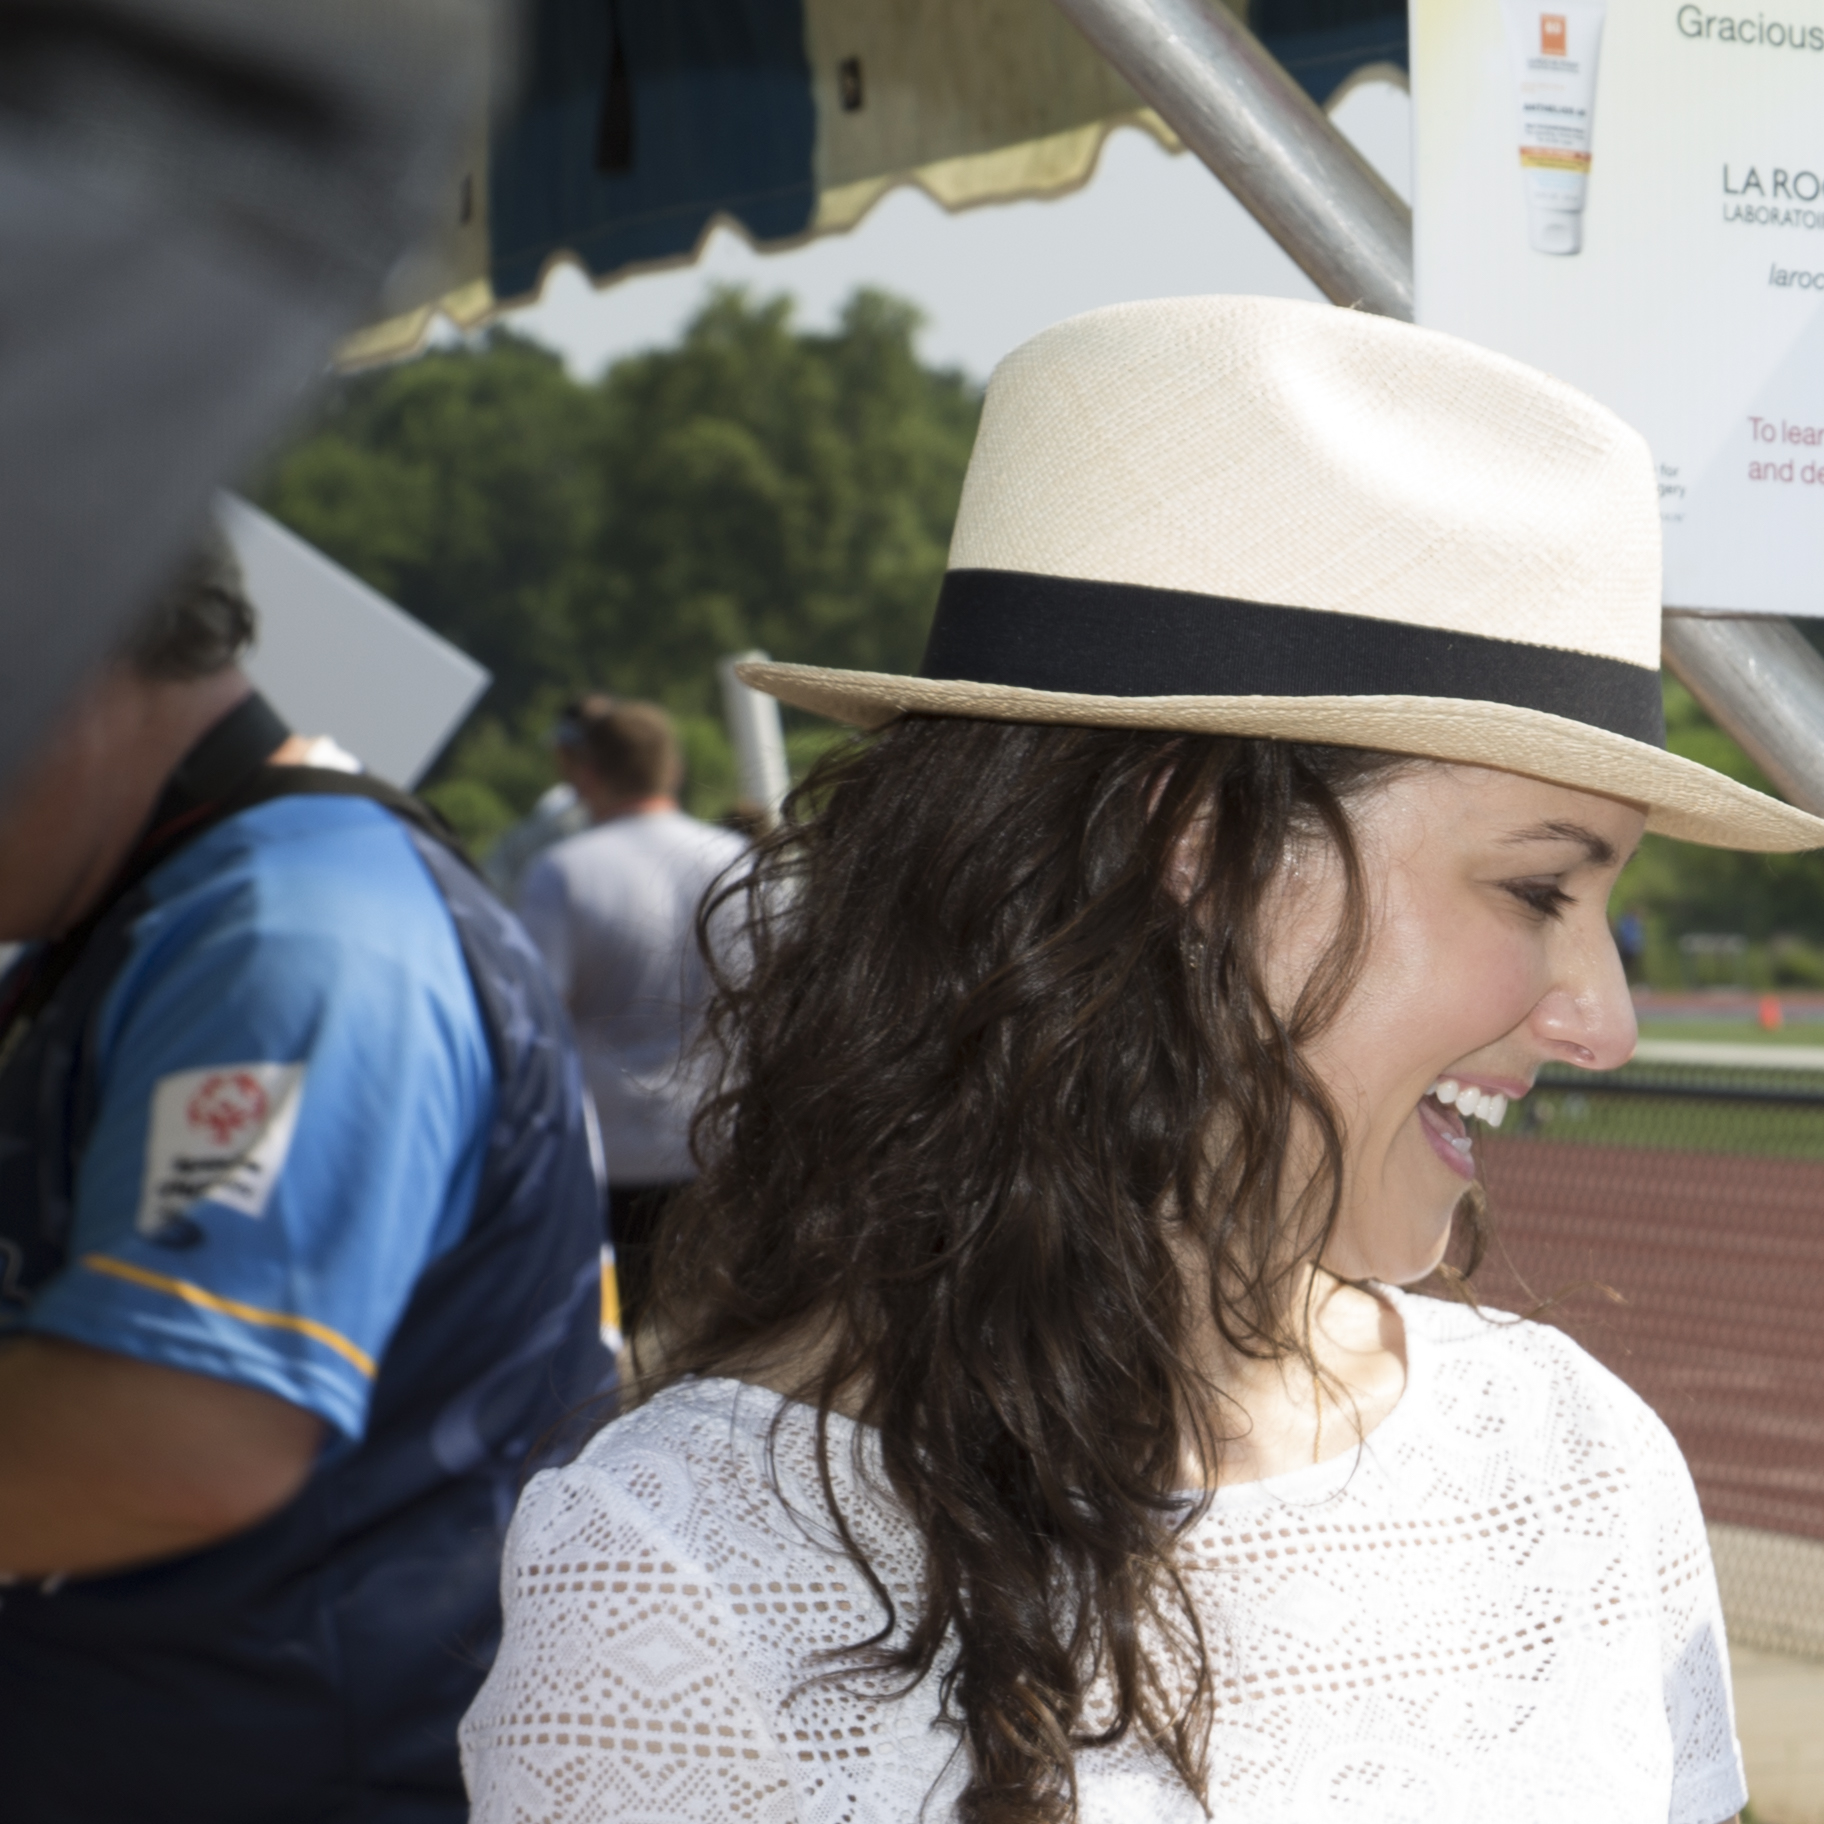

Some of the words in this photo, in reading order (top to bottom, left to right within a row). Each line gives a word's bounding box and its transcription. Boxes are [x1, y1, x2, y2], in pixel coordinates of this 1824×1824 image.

[1723, 163, 1765, 197] LA
[1748, 415, 1777, 444] To
[1748, 458, 1794, 484] and
